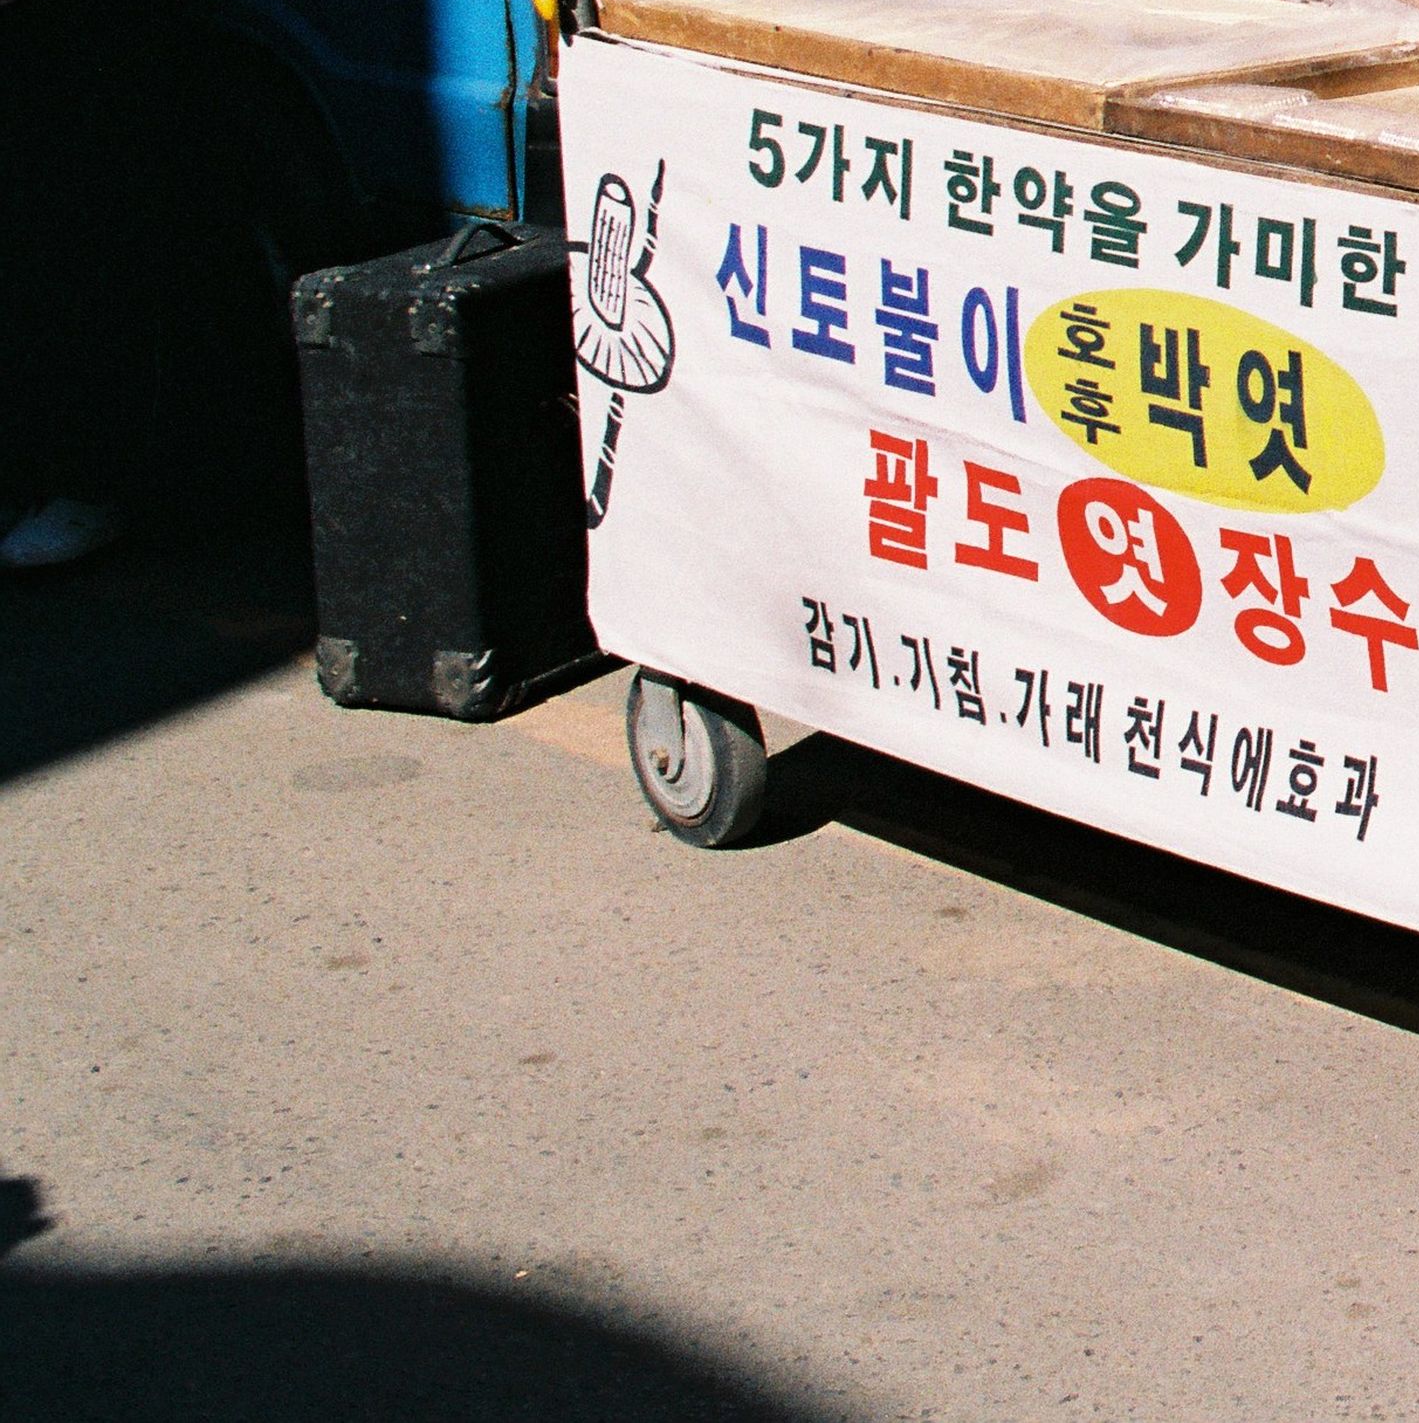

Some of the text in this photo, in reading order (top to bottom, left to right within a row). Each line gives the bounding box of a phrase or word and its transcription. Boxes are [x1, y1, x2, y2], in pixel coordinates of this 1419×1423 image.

[750, 109, 1406, 317] 5가지 한약을 가미한
[717, 223, 1027, 423] 신토불이
